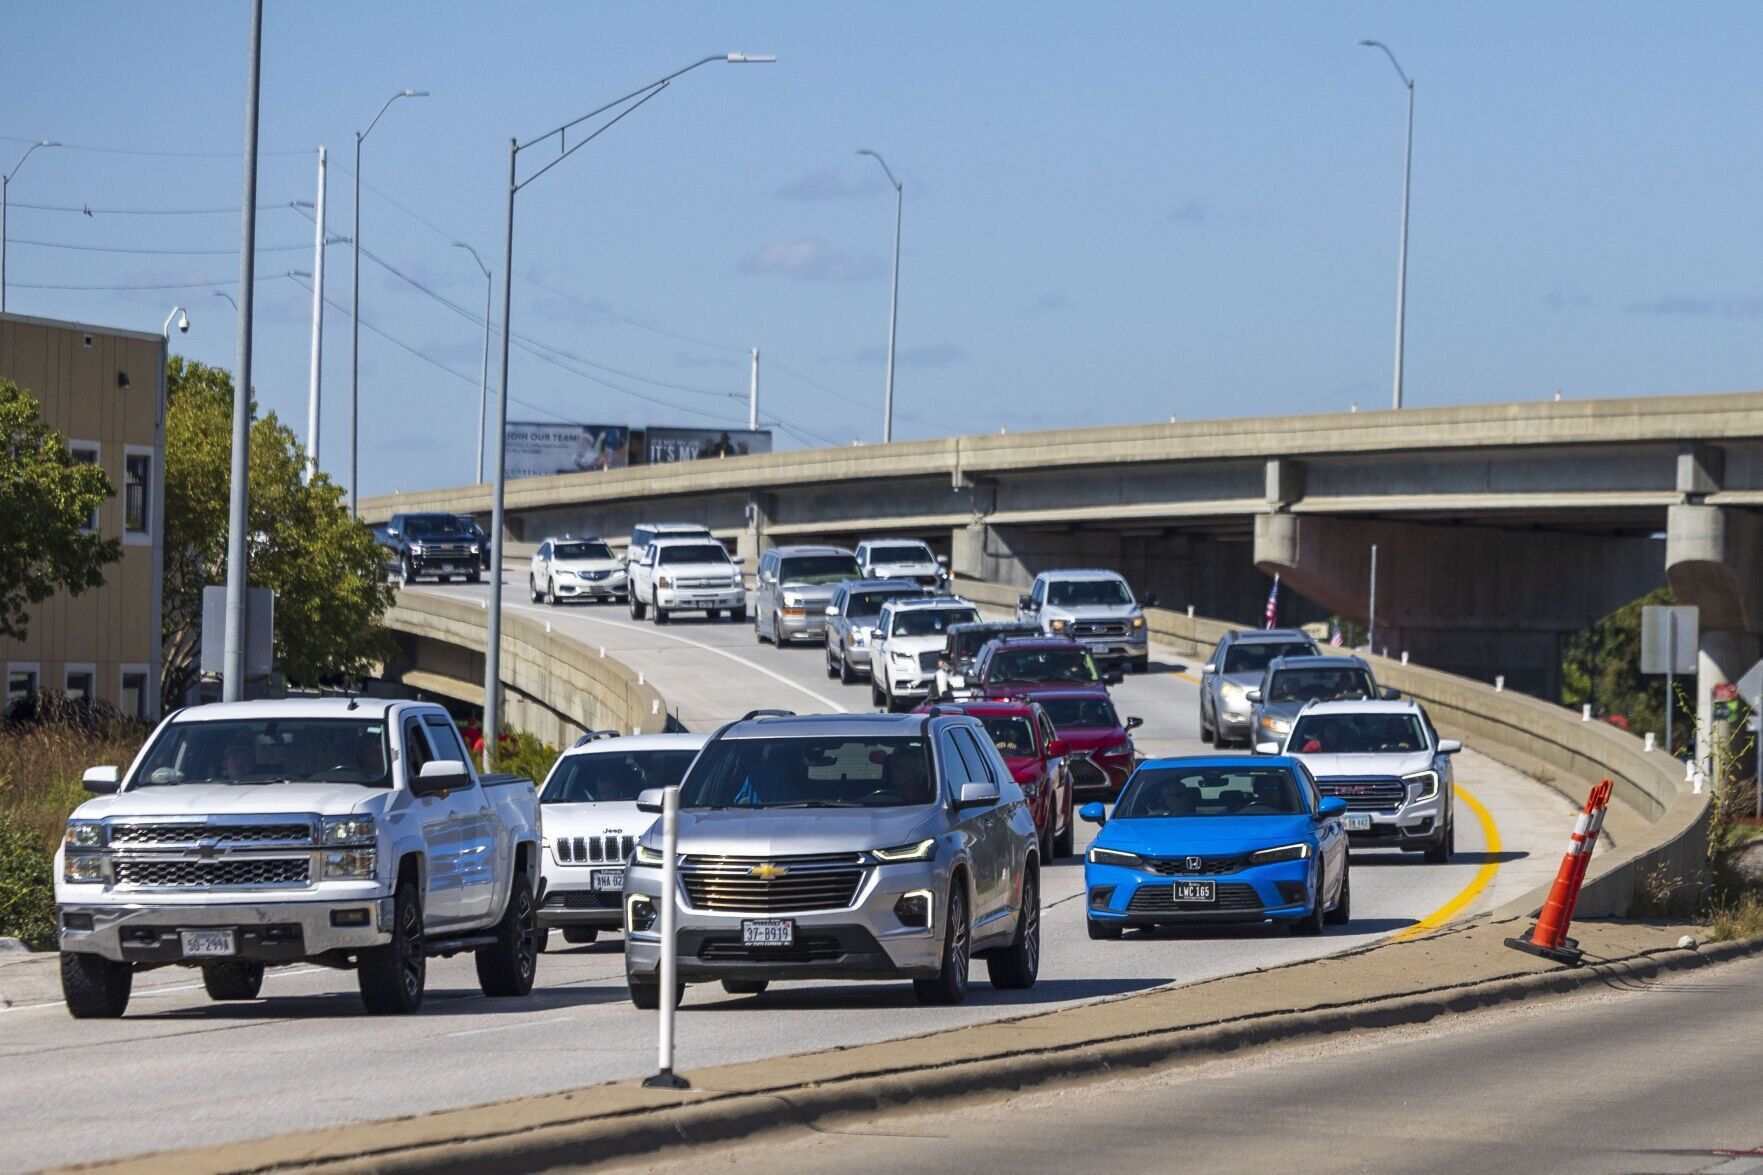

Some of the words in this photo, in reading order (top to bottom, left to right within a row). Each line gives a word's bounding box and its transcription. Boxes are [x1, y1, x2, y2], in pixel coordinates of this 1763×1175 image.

[530, 433, 551, 442] OUR
[651, 446, 675, 461] IT'S
[679, 447, 699, 461] MY
[1178, 886, 1194, 897] LWC
[1196, 886, 1209, 897] 165
[747, 927, 788, 941] 37-B919
